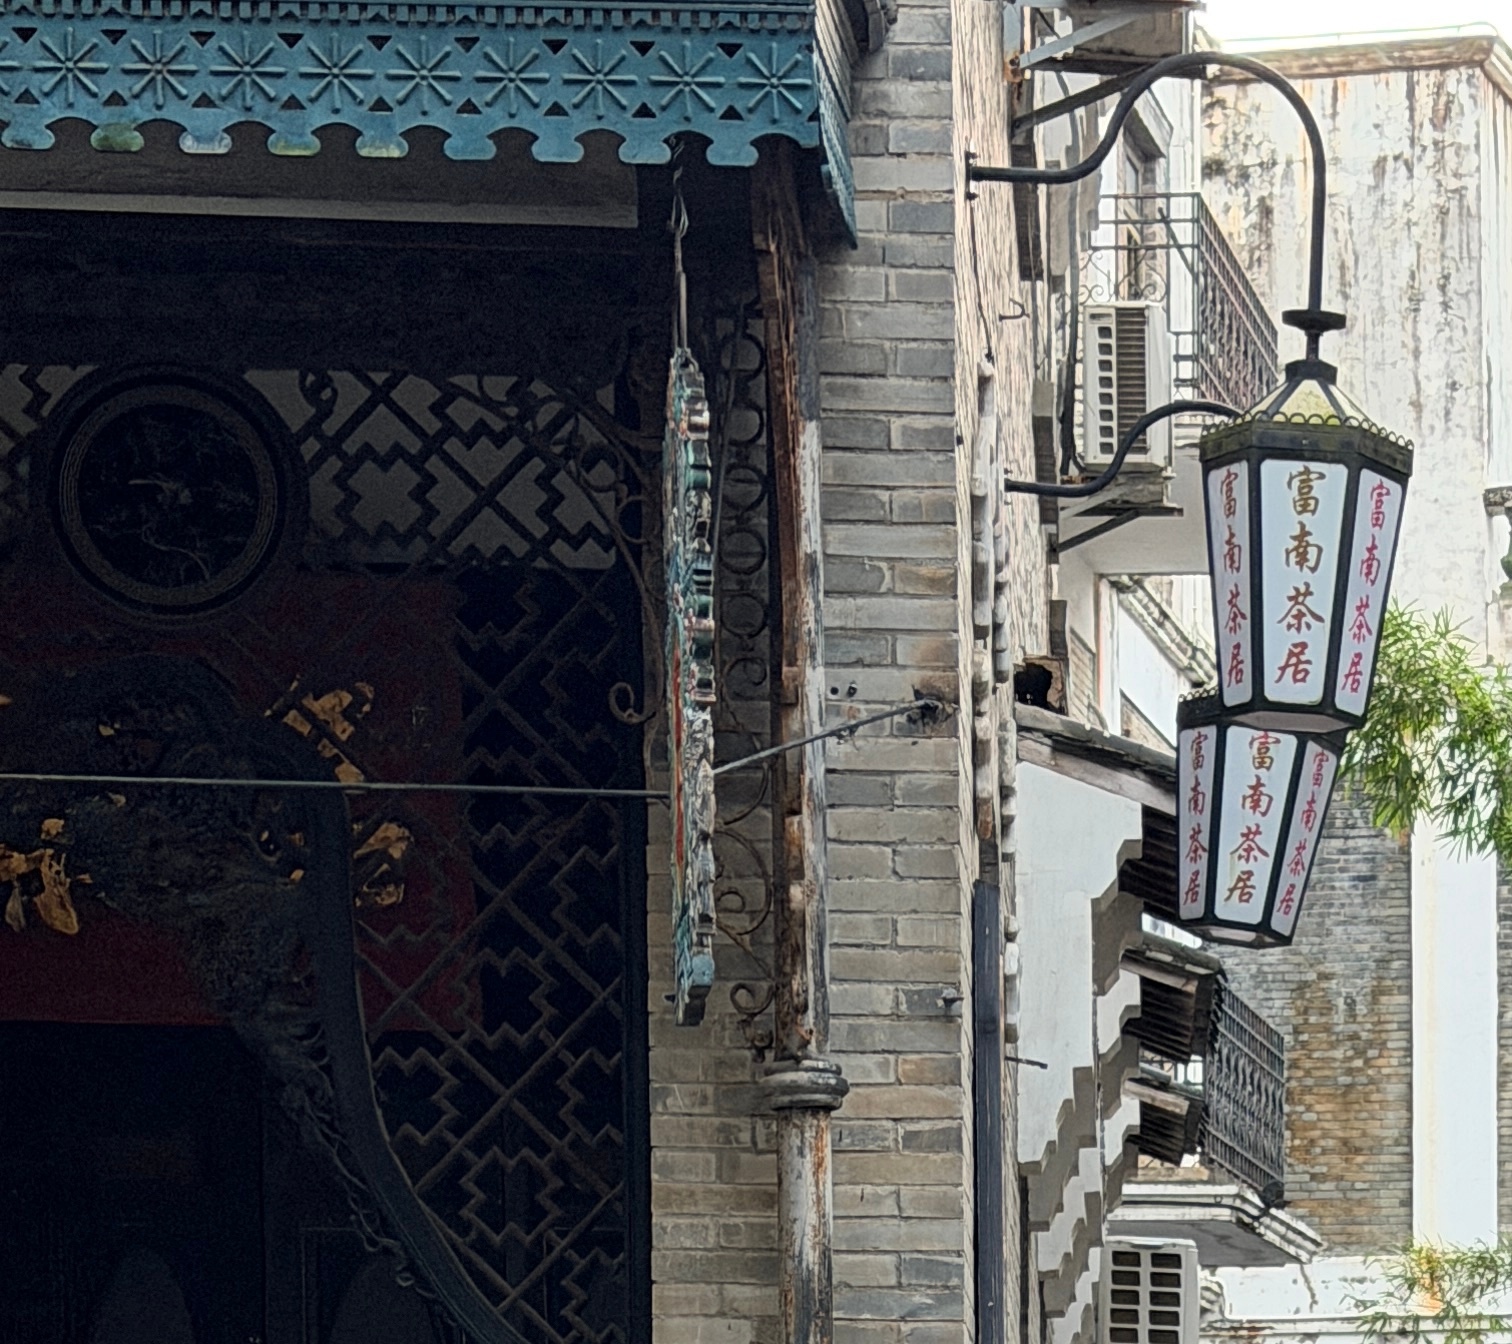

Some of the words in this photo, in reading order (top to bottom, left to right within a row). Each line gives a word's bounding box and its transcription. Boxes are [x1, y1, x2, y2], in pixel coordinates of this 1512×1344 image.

[1219, 467, 1249, 689] 富南茶居
[1273, 464, 1325, 686] 富南茶居
[1341, 479, 1391, 695] 富南茶居
[1182, 731, 1208, 905] 富南茶居
[1224, 730, 1282, 904] 富南茶居
[1276, 750, 1330, 917] 富南茶居
